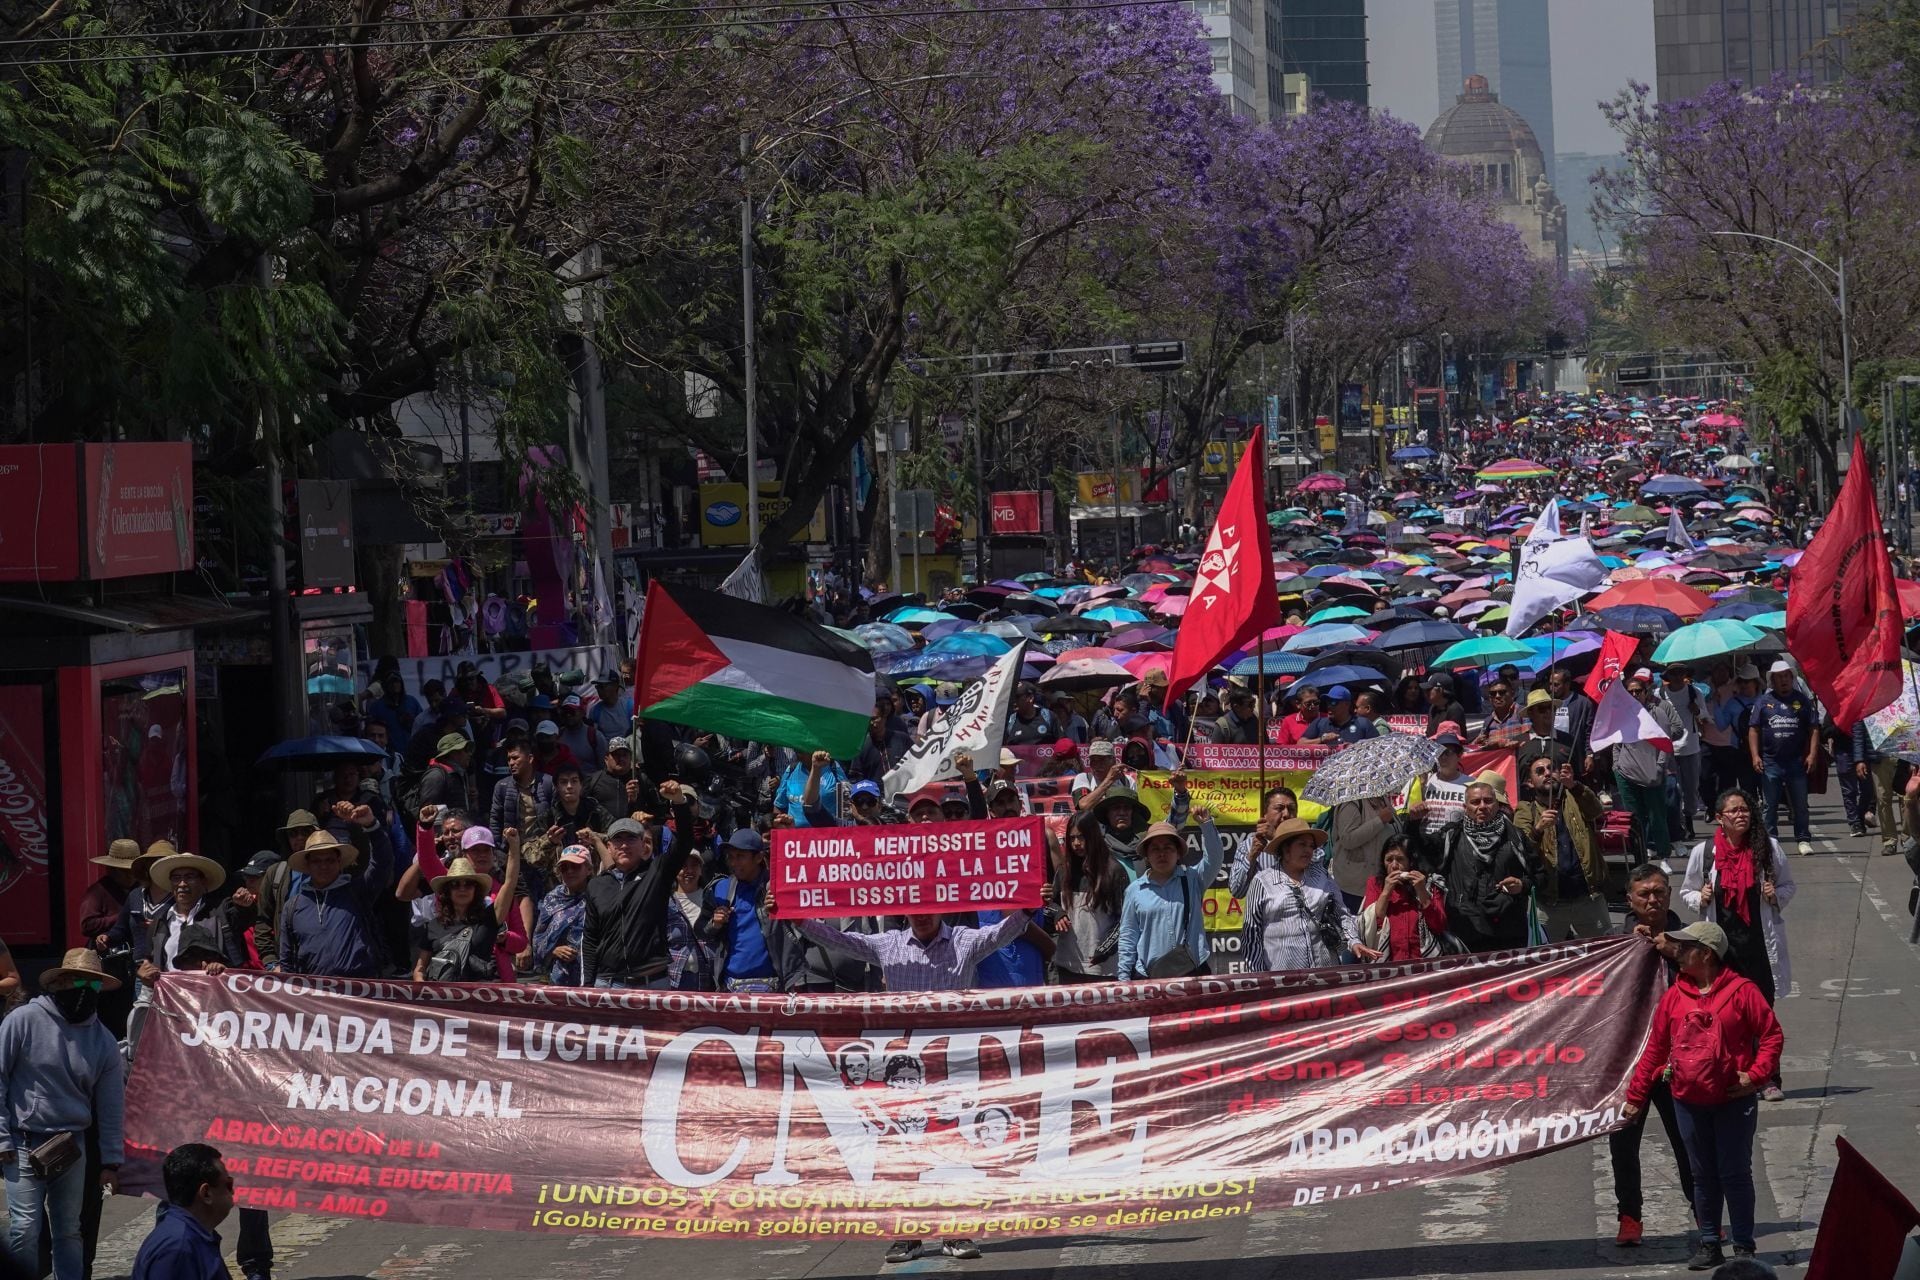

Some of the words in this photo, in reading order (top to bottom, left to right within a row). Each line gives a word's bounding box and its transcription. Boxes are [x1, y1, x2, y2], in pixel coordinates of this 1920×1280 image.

[784, 839, 861, 859] CLAUDIA,
[874, 832, 986, 856] MENTISSSTE
[996, 829, 1031, 849] CON
[785, 864, 808, 883] LA
[818, 857, 925, 882] ABROGACIÓN
[935, 858, 947, 878] A
[959, 857, 984, 876] LA
[995, 854, 1031, 875] LEY
[799, 888, 836, 908] DEL
[850, 885, 921, 906] ISSSTE
[935, 883, 960, 902] DE
[970, 880, 1019, 900] 2007
[1211, 936, 1241, 953] NO
[566, 987, 773, 1014] NACIONAL
[180, 1010, 393, 1056] JORNADA
[408, 1016, 470, 1057] DE
[496, 1019, 649, 1063] LUCHA
[286, 1074, 521, 1118] NACIONAL
[640, 1017, 1151, 1188] CNTE
[203, 1117, 386, 1157] ABROGACIÓN
[387, 1138, 414, 1158] DE
[416, 1140, 441, 1160] LA
[254, 1156, 371, 1187] REFORMA
[378, 1166, 514, 1196] EDUCATIVA
[318, 1192, 389, 1218] AMLO
[537, 1183, 690, 1208] ¡UNIDOS
[702, 1187, 720, 1208] Y
[531, 1209, 668, 1232] ¡Gobierne
[675, 1215, 751, 1236] quien
[757, 1214, 885, 1237] gobierne,
[893, 1213, 932, 1235] los
[940, 1213, 1061, 1234] derechos
[1068, 1210, 1098, 1229] se
[1104, 1200, 1254, 1228] defienden!
